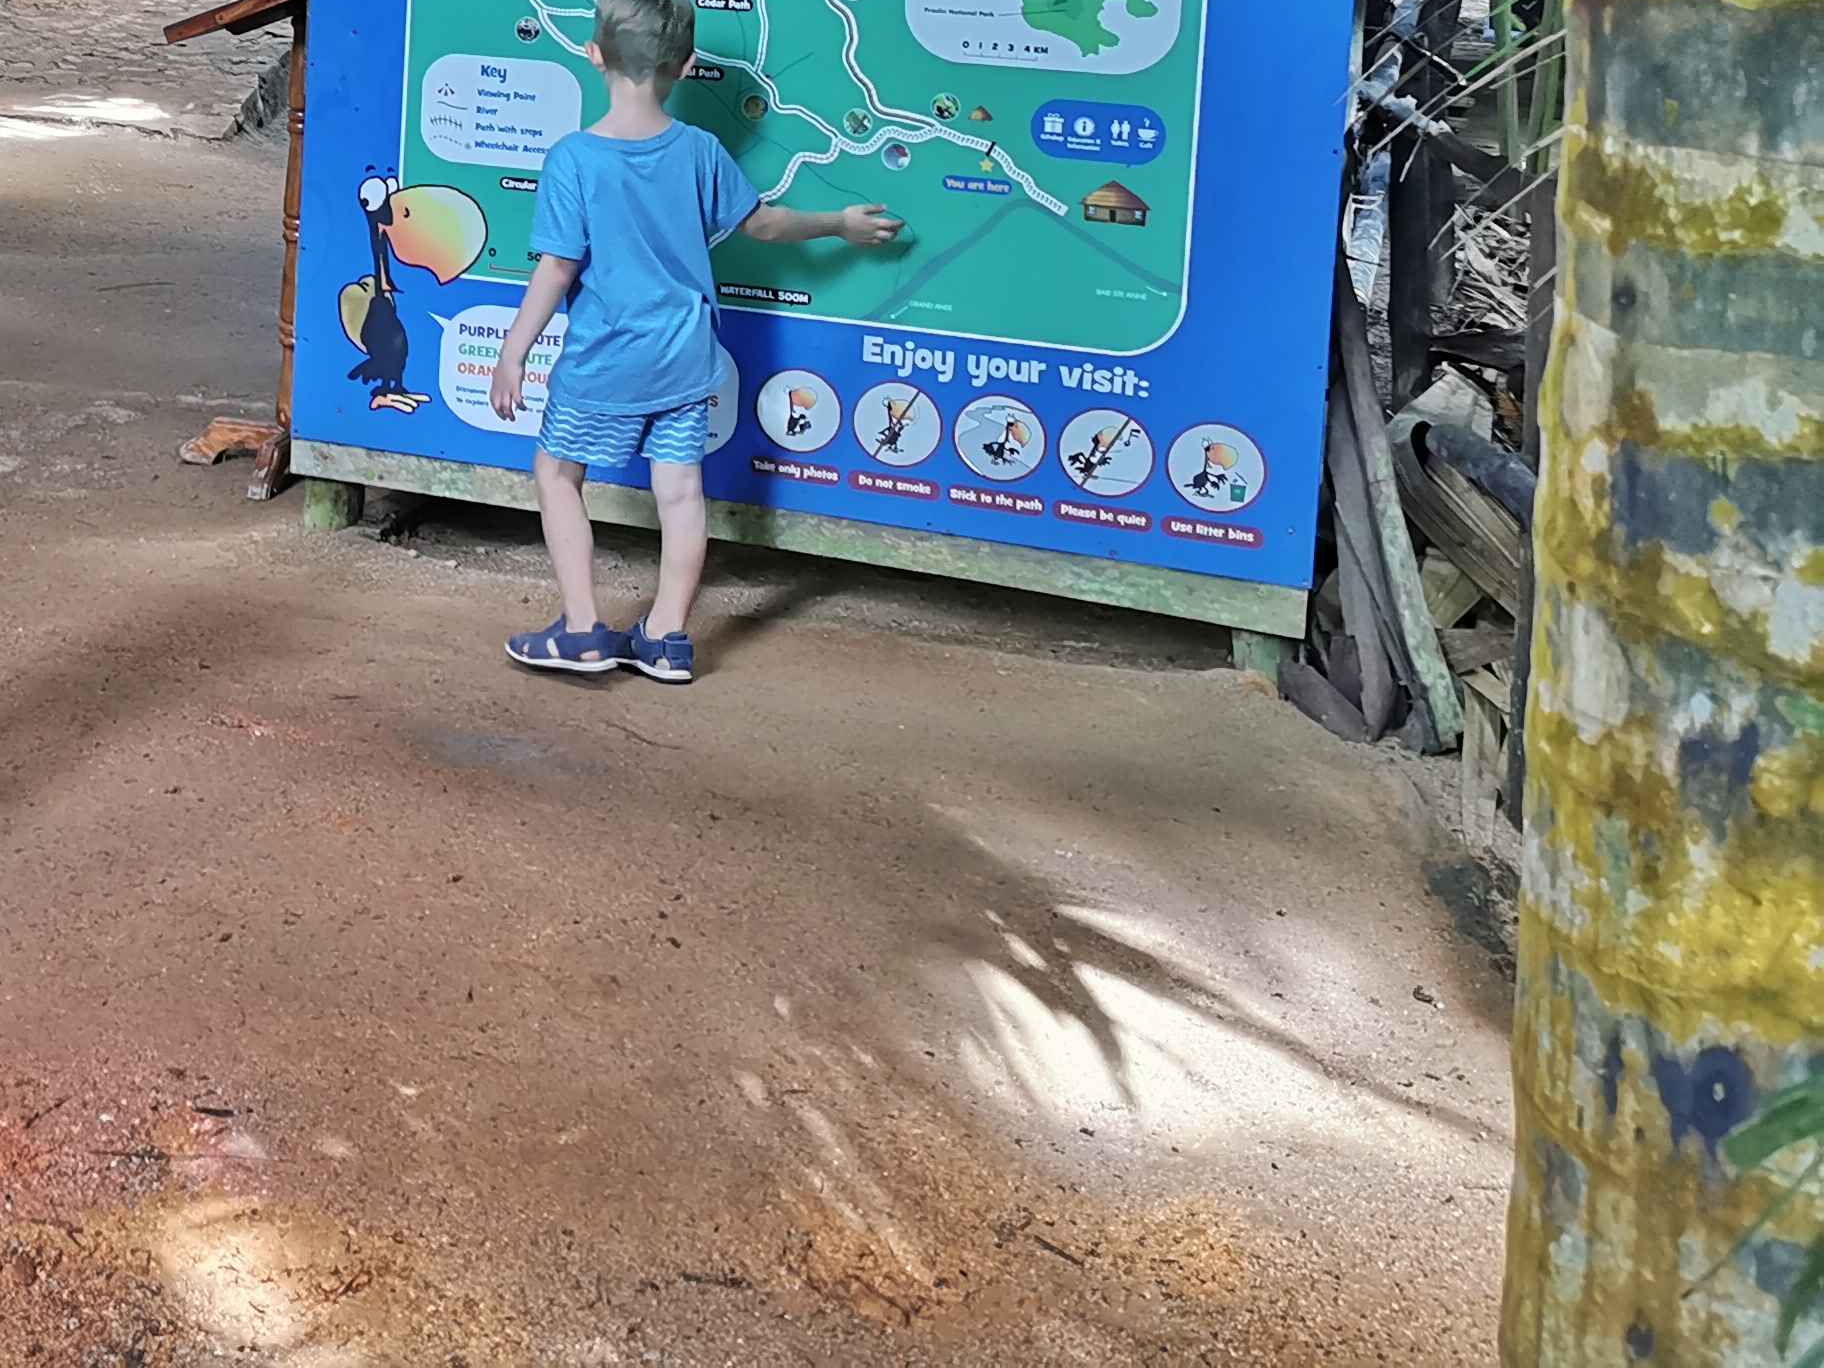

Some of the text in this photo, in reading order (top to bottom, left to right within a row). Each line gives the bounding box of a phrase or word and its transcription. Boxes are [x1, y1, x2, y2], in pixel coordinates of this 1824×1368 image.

[992, 42, 999, 50] 2
[1008, 43, 1015, 52] 3
[1023, 45, 1031, 54] 4
[480, 64, 508, 83] Key
[477, 89, 536, 101] Viewing Point
[476, 105, 498, 115] River
[475, 122, 543, 138] Path with steps
[501, 177, 538, 190] Circular
[946, 177, 1010, 193] You are here
[488, 247, 497, 257] 0
[720, 284, 809, 303] WATERFALL 500M
[862, 334, 1150, 399] Enjoy your visit:
[753, 458, 839, 483] Take only photos
[858, 474, 932, 495] Do not smoke
[950, 487, 1043, 513] Stick to the path
[1060, 503, 1147, 529] Please be quiet
[1171, 520, 1255, 544] Use litter bins
